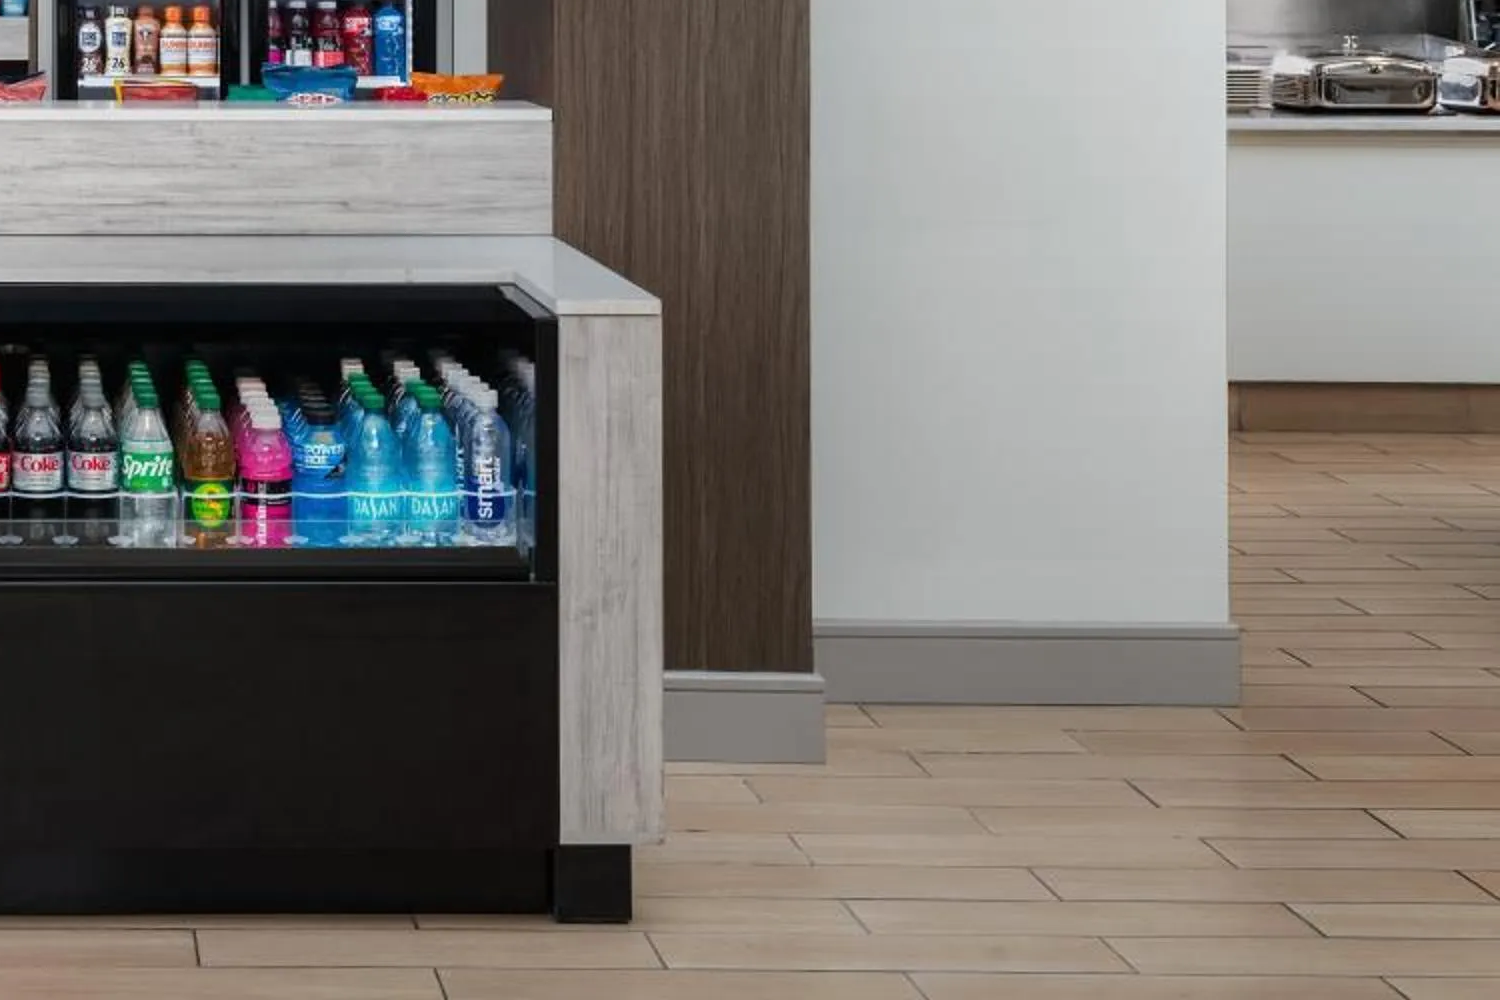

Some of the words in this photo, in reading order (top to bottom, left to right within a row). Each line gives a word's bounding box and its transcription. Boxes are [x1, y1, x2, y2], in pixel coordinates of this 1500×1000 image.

[20, 456, 59, 472] Coke
[72, 455, 111, 472] Coke
[122, 455, 173, 479] Sprite
[478, 456, 493, 519] smart
